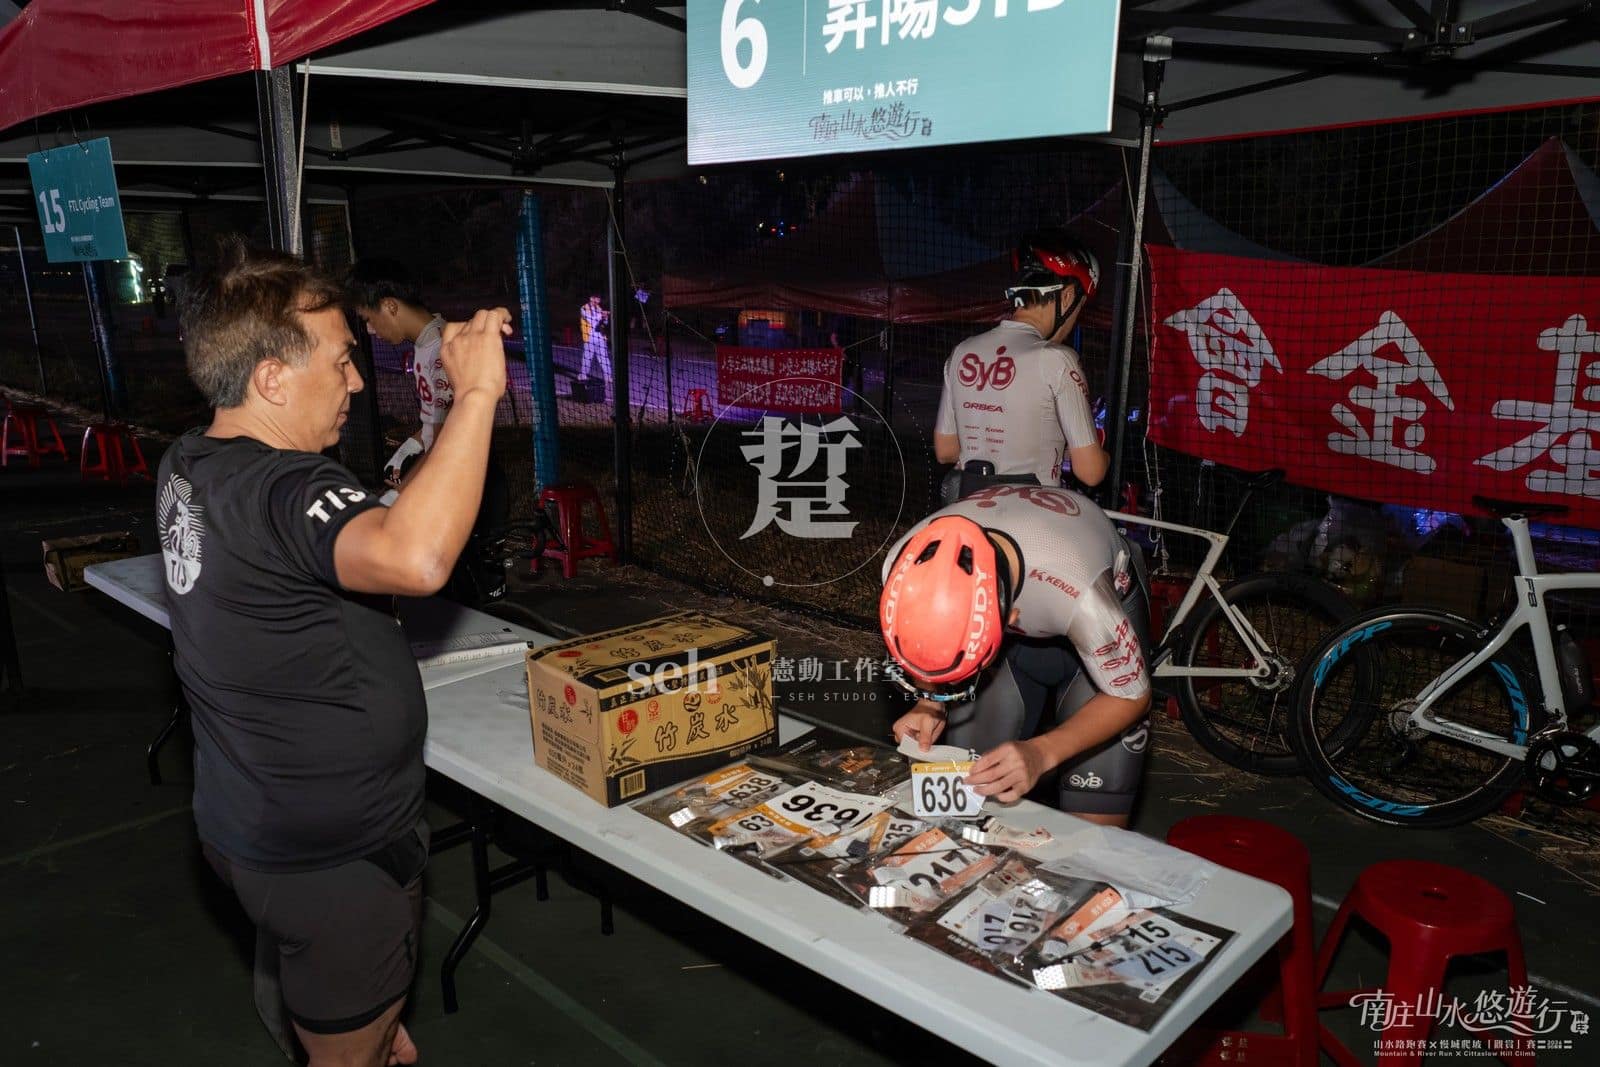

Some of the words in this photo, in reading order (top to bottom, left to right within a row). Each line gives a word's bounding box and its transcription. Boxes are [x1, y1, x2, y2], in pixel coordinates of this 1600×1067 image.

[721, 0, 768, 88] 6
[40, 189, 65, 233] 15
[963, 401, 1003, 413] ORBEA
[1046, 575, 1081, 599] KENDA
[965, 564, 988, 661] RUDY
[655, 703, 739, 753] 竹炭水
[921, 776, 967, 812] 636
[1069, 772, 1104, 789] SyB
